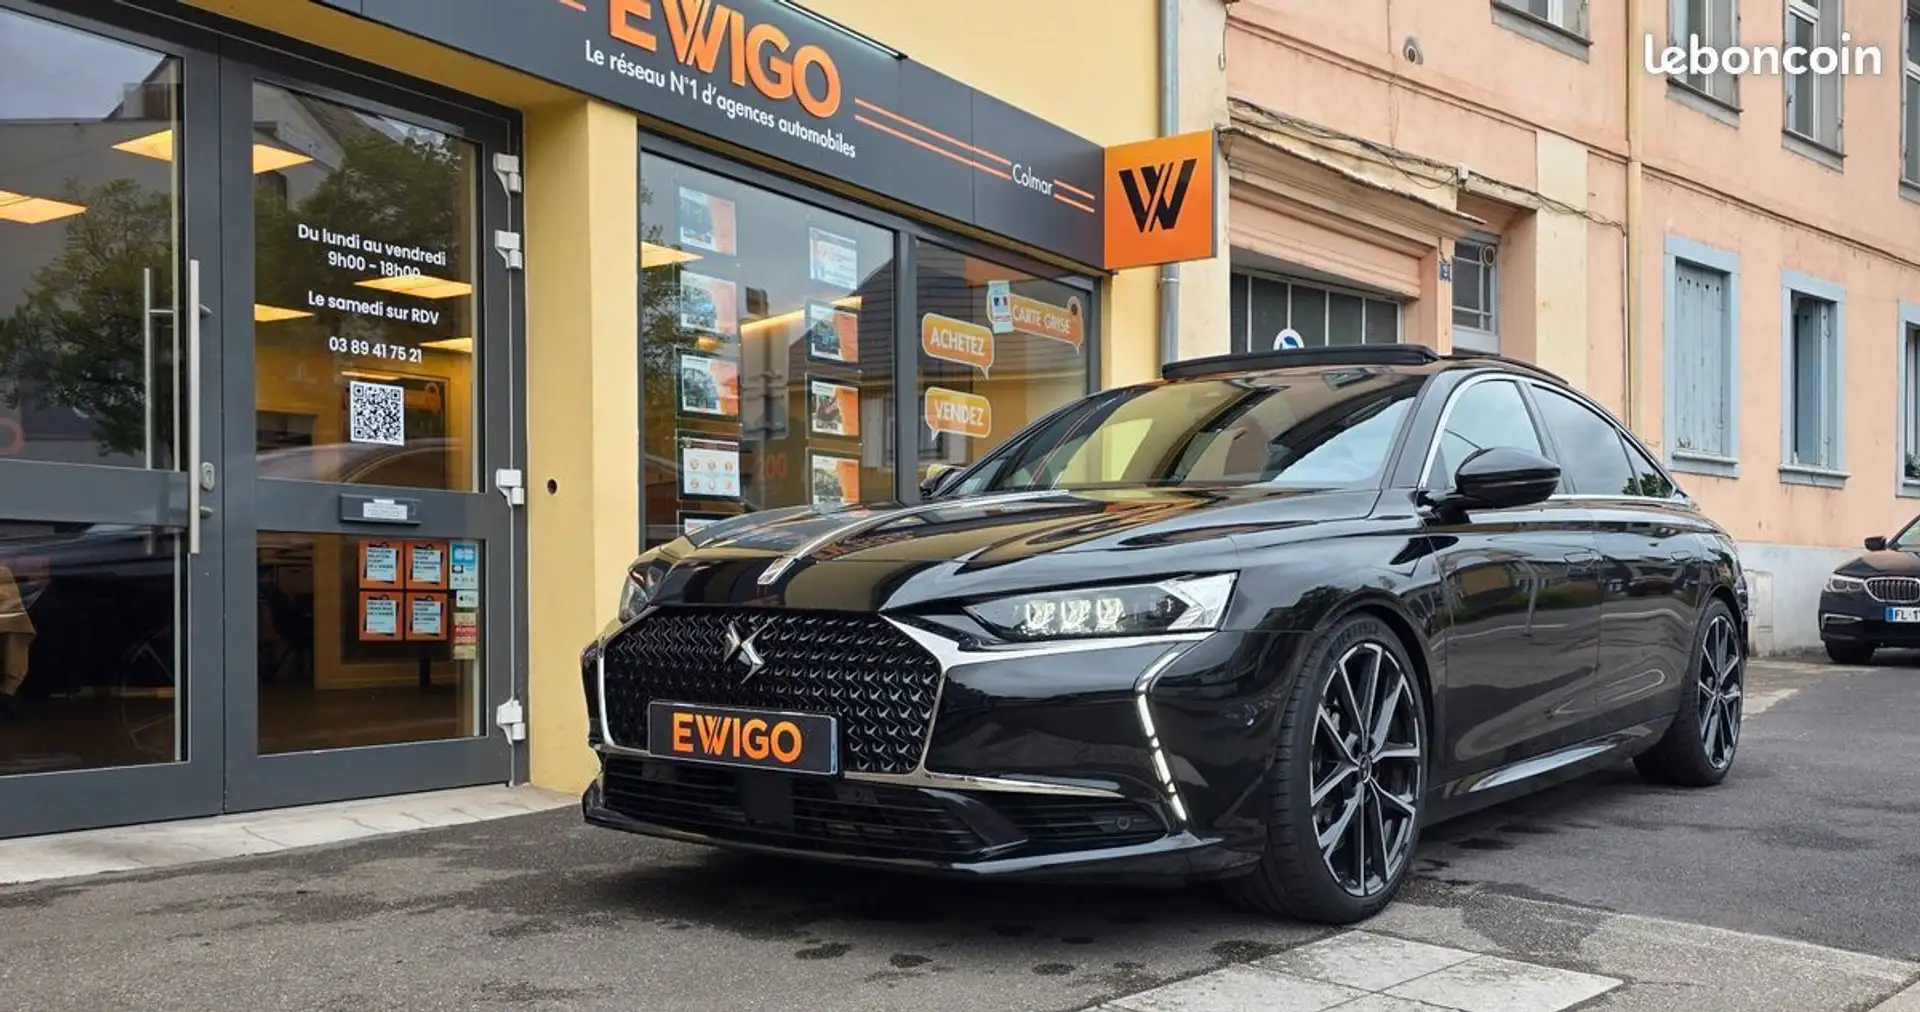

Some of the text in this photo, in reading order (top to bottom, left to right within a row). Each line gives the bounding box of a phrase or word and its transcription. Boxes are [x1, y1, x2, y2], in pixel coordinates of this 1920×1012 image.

[608, 0, 842, 118] EWIGO
[584, 39, 605, 66] Le
[609, 51, 666, 87] réseau
[778, 117, 856, 159] automobiles
[1012, 163, 1054, 197] Colmar
[298, 223, 446, 266] Du lundi au vendredi
[328, 251, 366, 271] 9h00
[380, 261, 421, 278] 18h00
[308, 290, 440, 326] Le samedi sur RDV
[1012, 304, 1042, 327] CARTE
[329, 336, 422, 363] 03 89 41 75 21
[930, 327, 985, 357] ACHETEZ
[934, 398, 985, 426] VENDEZ
[672, 712, 803, 763] EWIGO
